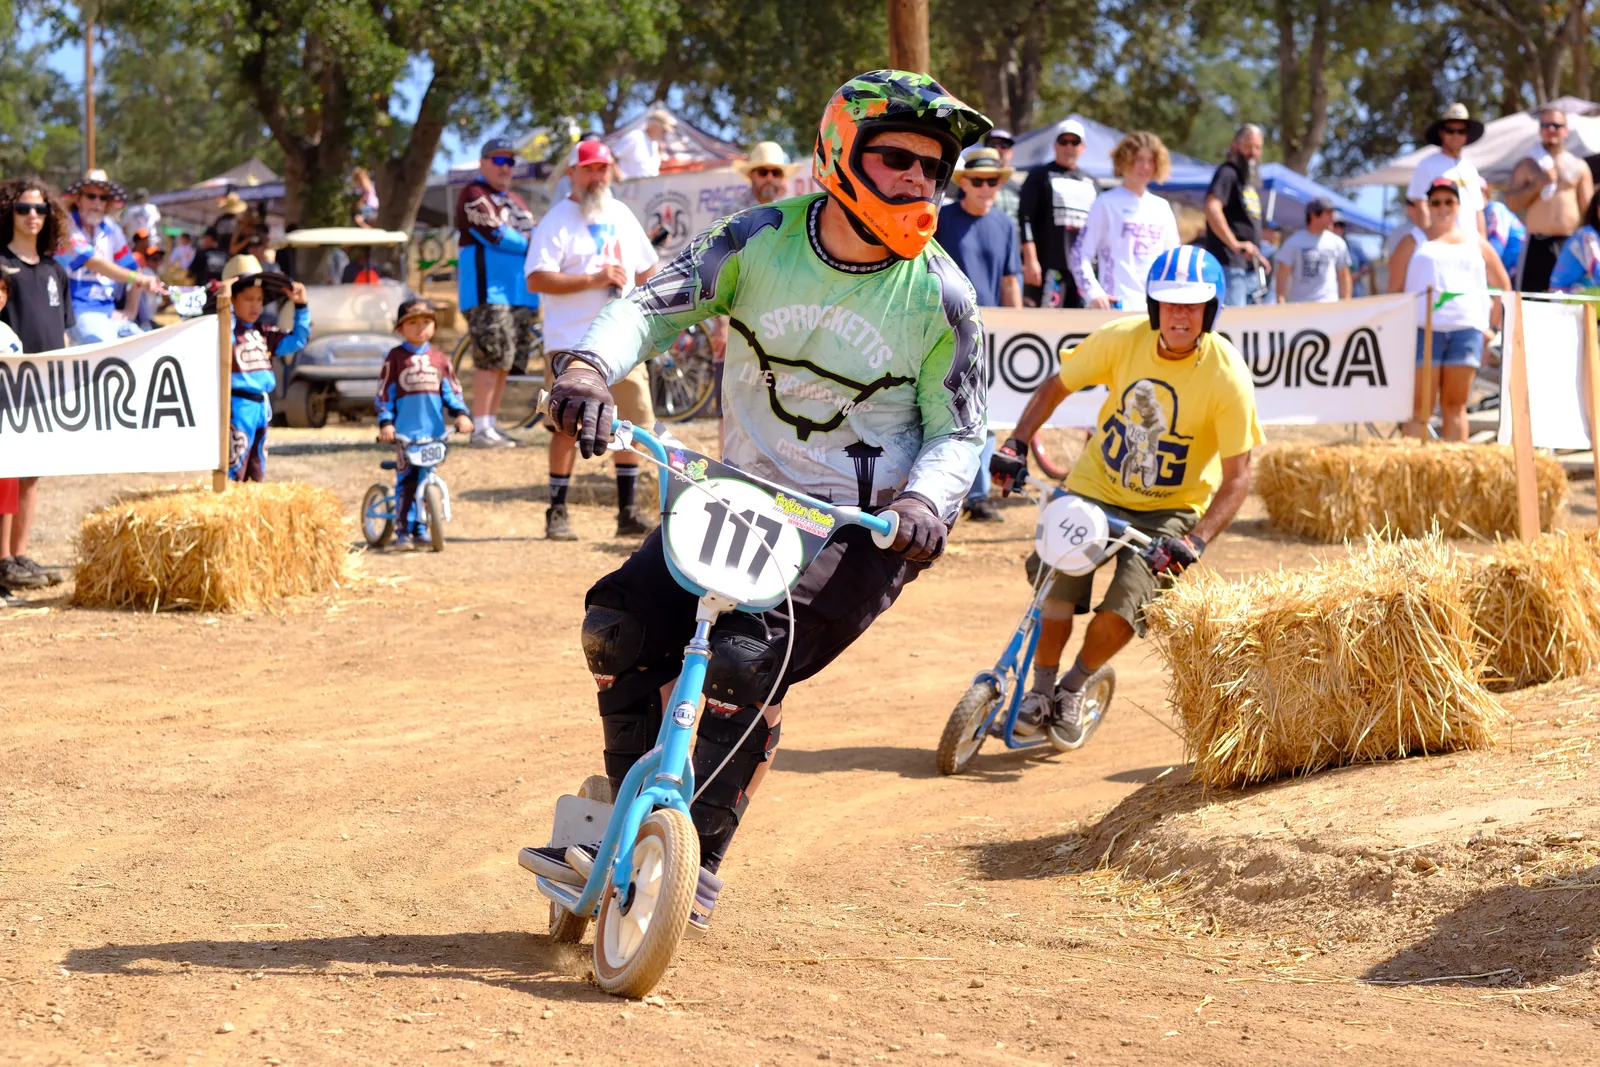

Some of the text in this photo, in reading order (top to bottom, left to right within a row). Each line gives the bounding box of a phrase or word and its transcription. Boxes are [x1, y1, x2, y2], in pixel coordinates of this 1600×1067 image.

[759, 304, 893, 369] SPROCKETTS
[1219, 327, 1388, 388] URA
[0, 355, 196, 434] MURA
[1128, 482, 1175, 499] Reunio
[698, 498, 783, 586] 117
[1058, 517, 1088, 546] 48
[707, 699, 738, 710] EVS
